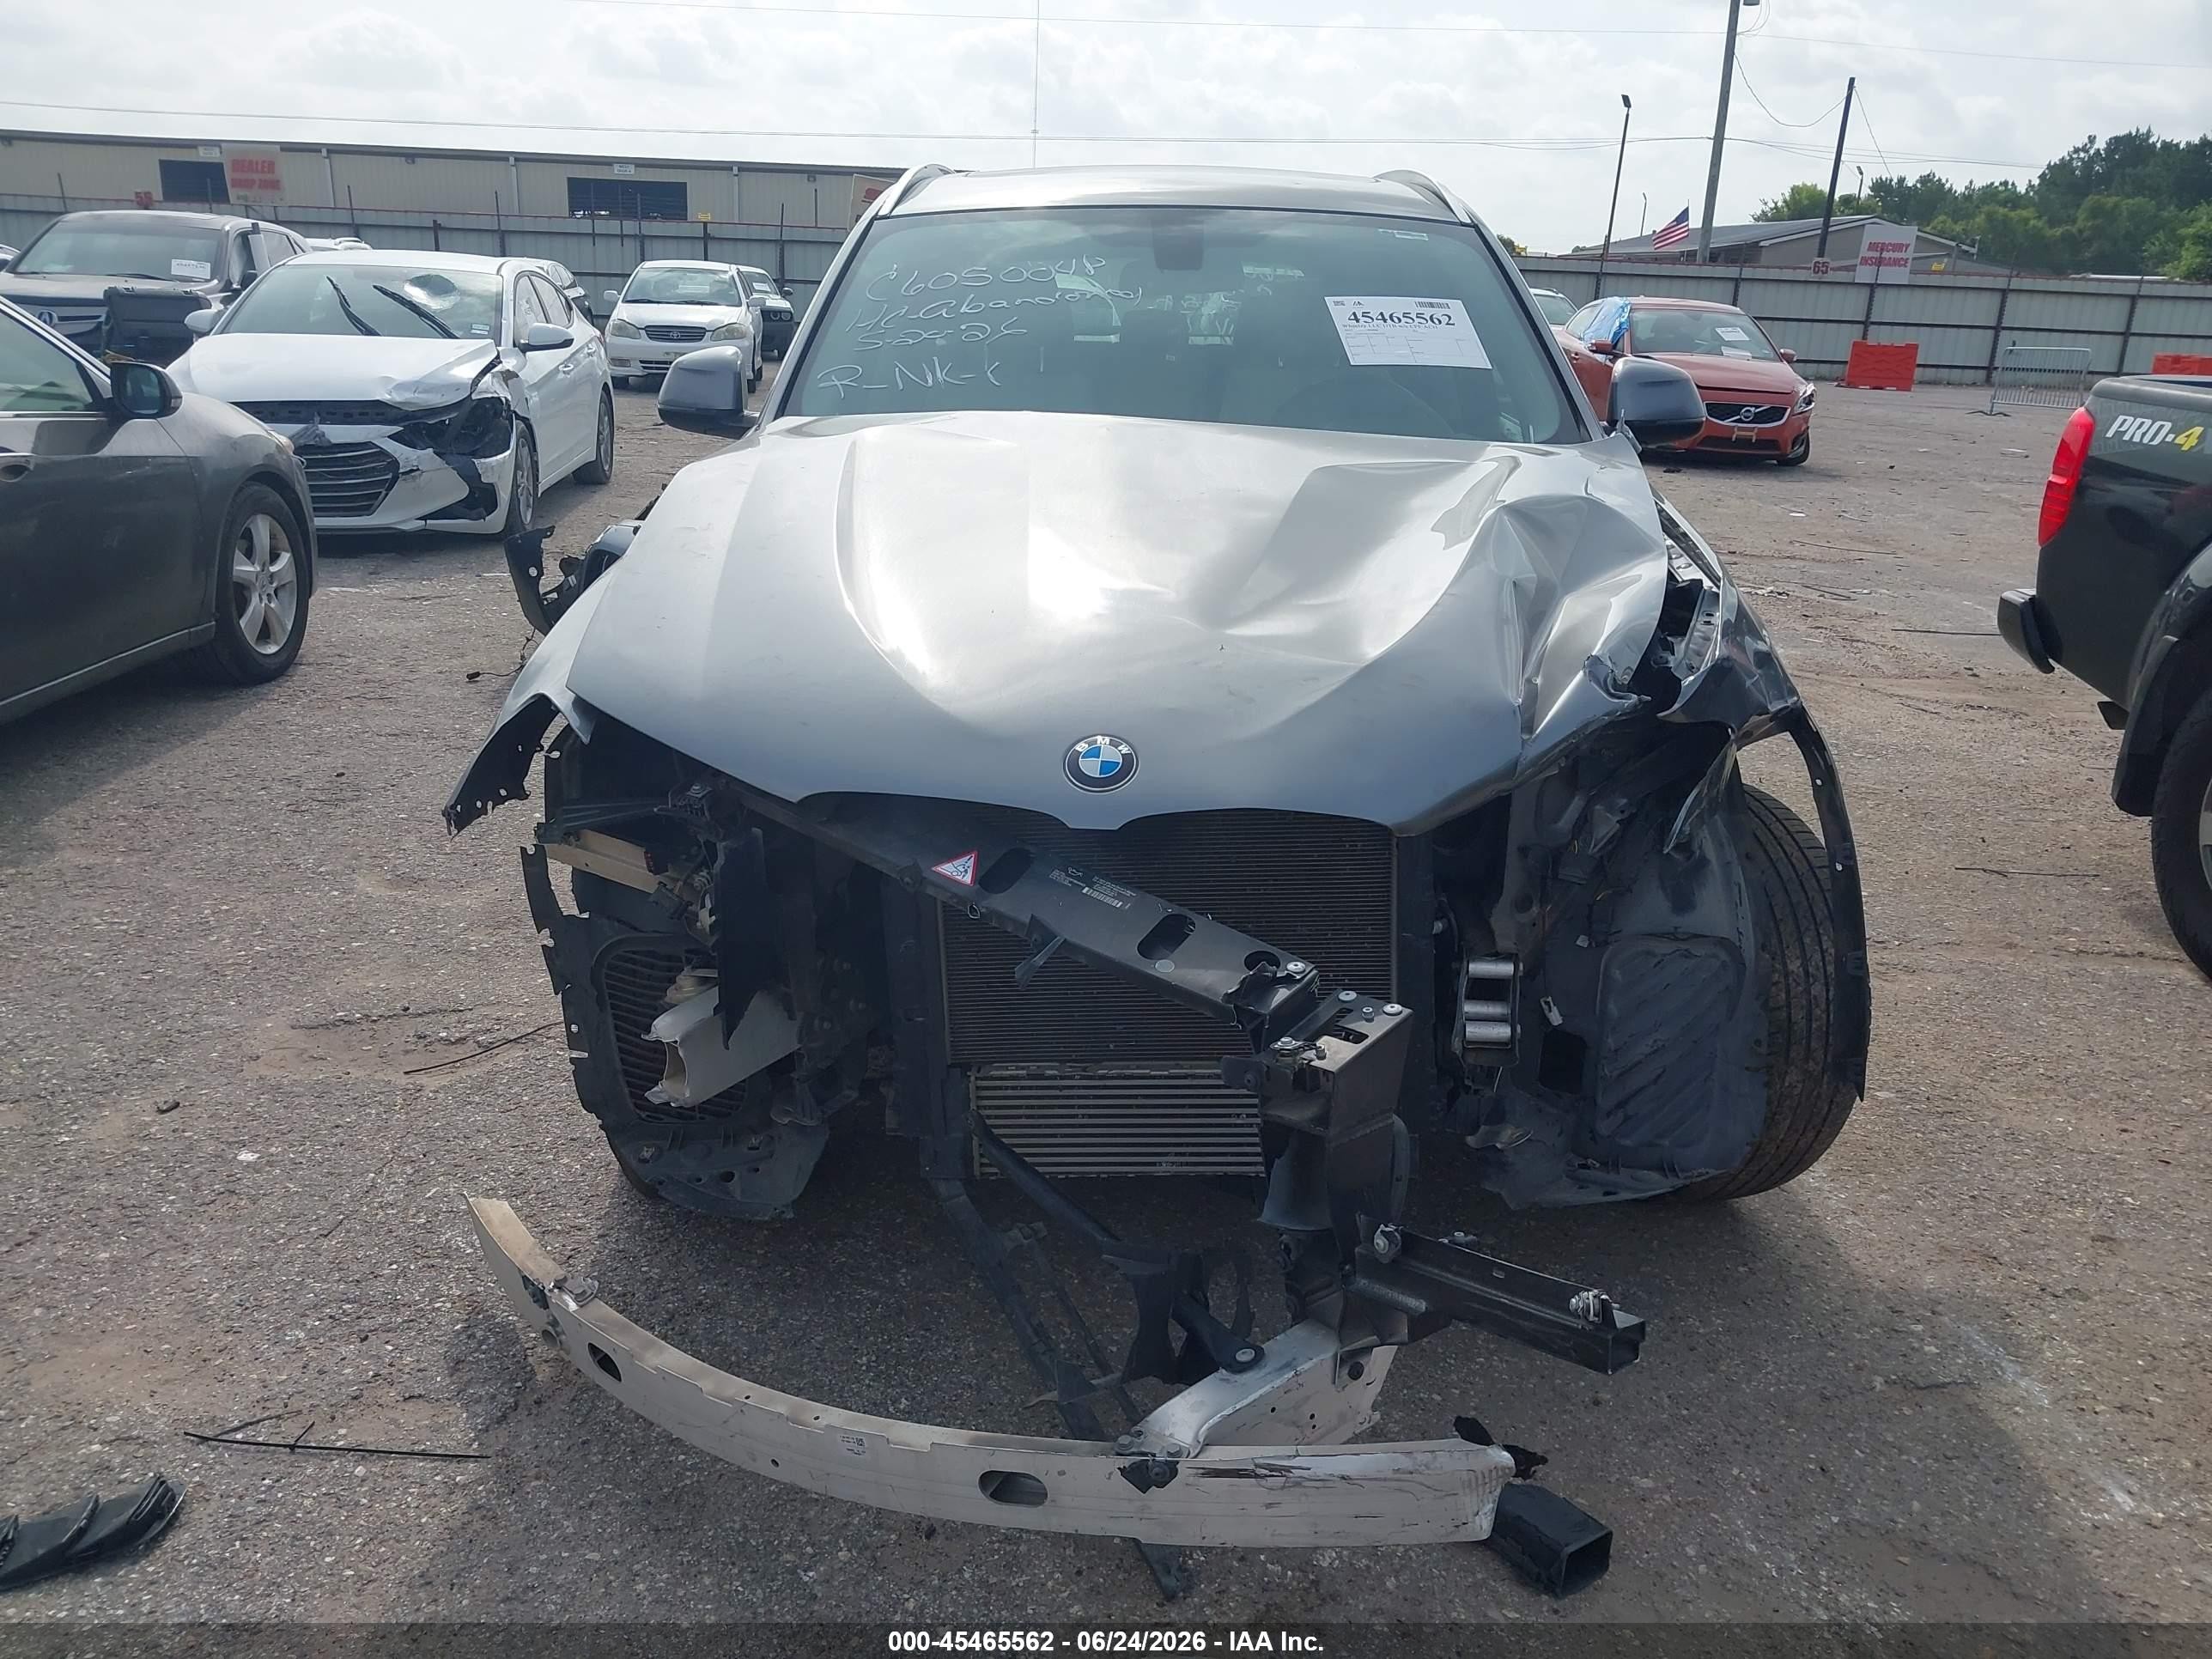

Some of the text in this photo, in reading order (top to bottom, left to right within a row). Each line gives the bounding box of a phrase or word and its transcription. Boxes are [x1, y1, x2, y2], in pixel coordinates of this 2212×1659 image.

[1867, 241, 1911, 253] MERCURY
[1812, 260, 1830, 275] 65
[1859, 256, 1910, 268] INSURANCE
[1347, 311, 1455, 326] 45465562
[1075, 735, 1132, 755] BMW
